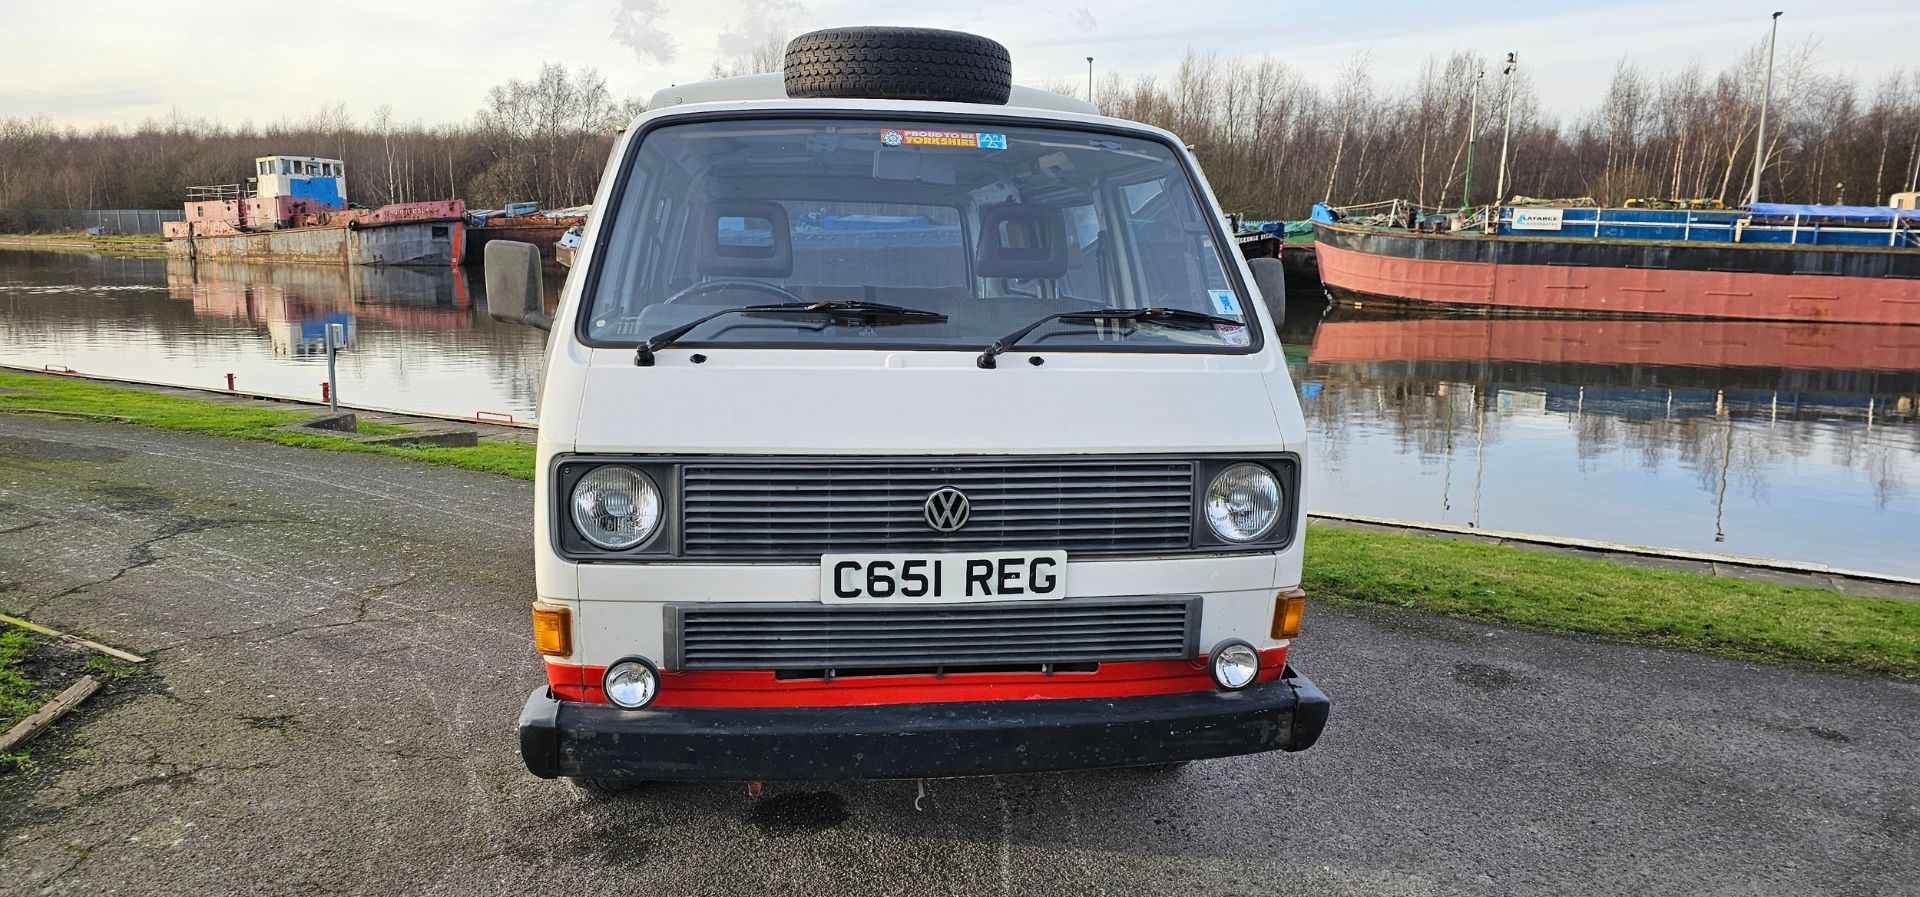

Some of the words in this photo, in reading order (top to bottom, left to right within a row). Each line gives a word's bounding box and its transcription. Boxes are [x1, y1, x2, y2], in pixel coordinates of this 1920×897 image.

[904, 130, 943, 138] PROUD
[905, 136, 977, 146] YORKSHIRE
[833, 559, 942, 599] C651
[965, 556, 1057, 597] REG
